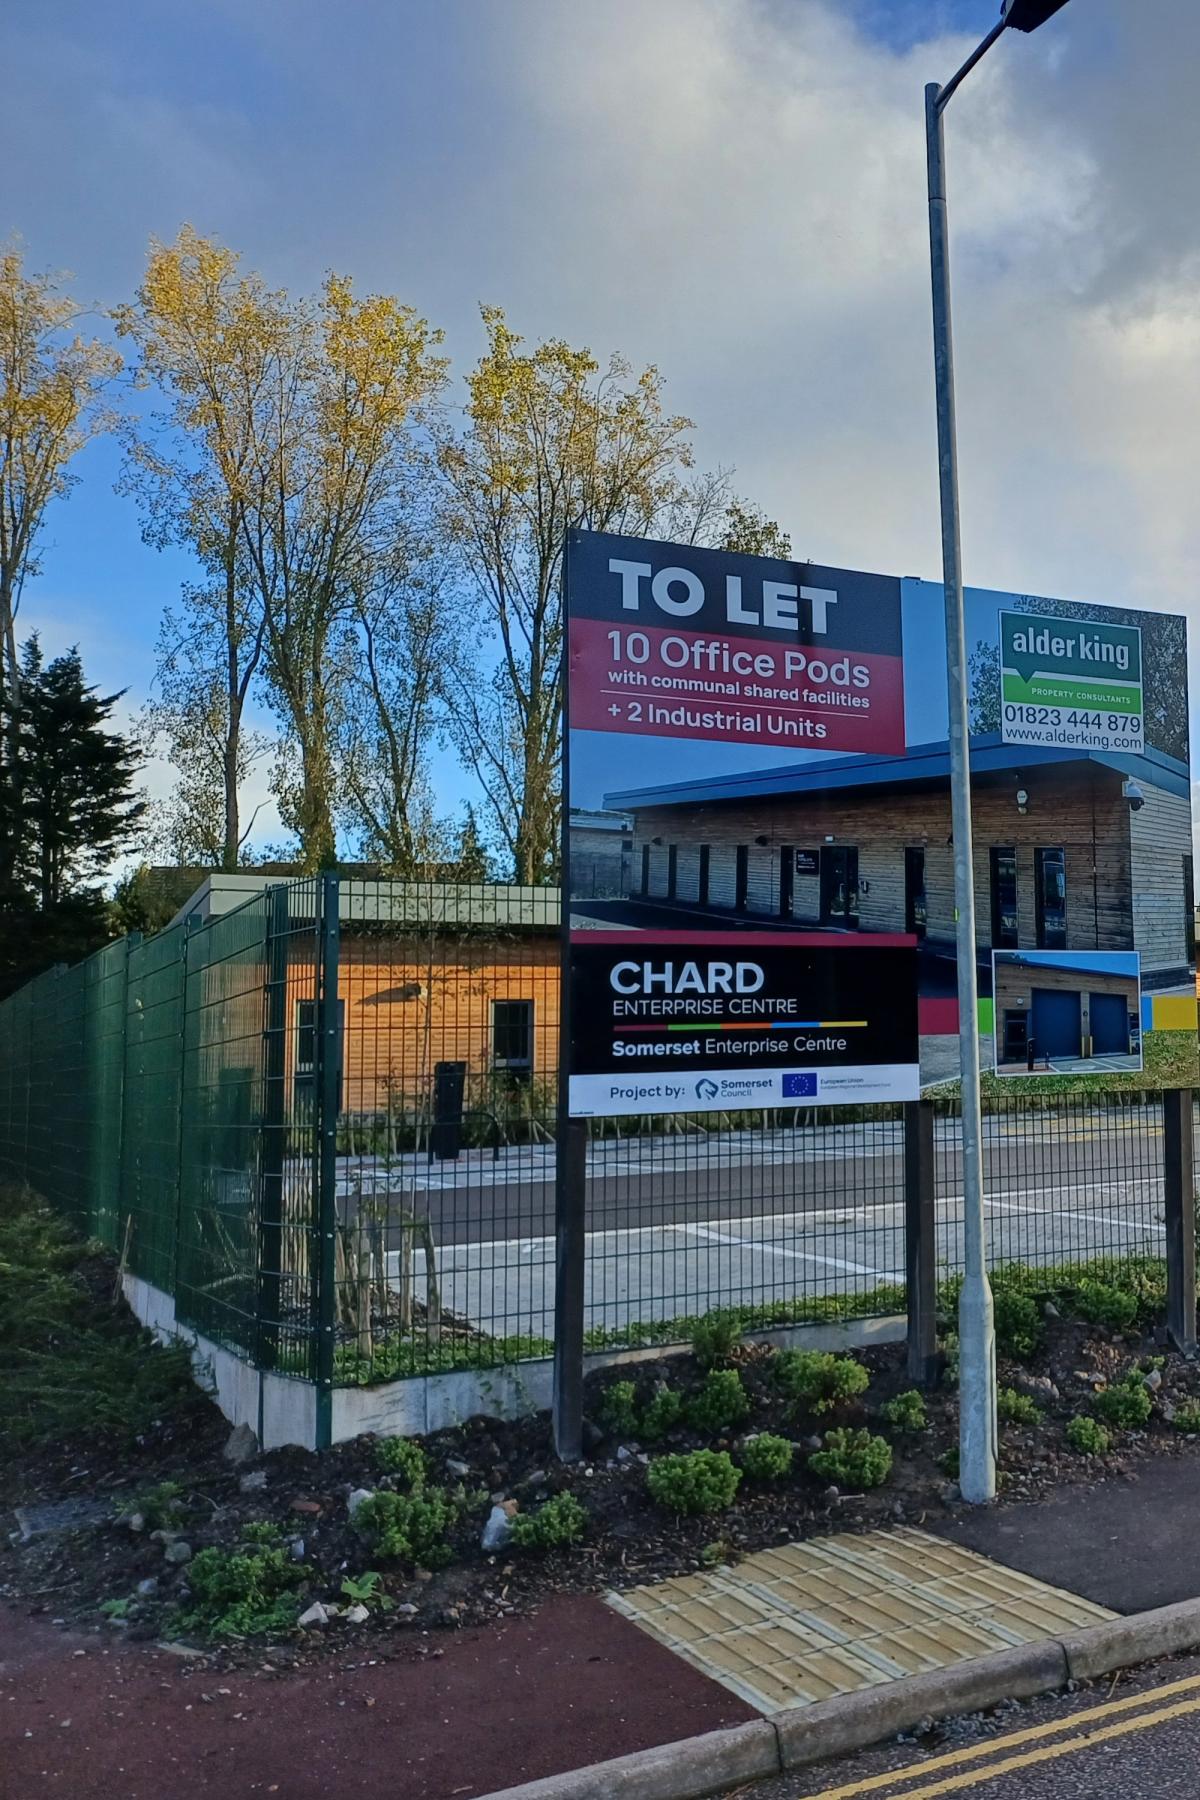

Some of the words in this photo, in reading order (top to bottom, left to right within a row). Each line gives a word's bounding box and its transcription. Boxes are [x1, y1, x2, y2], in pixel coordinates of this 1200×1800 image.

[608, 558, 705, 617] TO
[726, 575, 838, 634] LET
[607, 630, 650, 663] 10
[660, 637, 775, 678] Office
[785, 650, 870, 688] Pods
[1013, 627, 1075, 658] alder
[1079, 633, 1129, 670] king
[608, 670, 647, 686] with
[651, 674, 740, 696] communal
[744, 683, 799, 702] shared
[802, 689, 870, 709] facilities
[1031, 687, 1073, 698] PROPERTY
[1076, 692, 1131, 704] CONSULTANTS
[608, 704, 621, 716] +
[627, 702, 642, 722] 2
[649, 703, 761, 732] Industrial
[768, 715, 827, 738] Units
[1005, 704, 1061, 726] 01823
[1067, 711, 1102, 730] 444
[1107, 714, 1140, 733] 879
[1006, 727, 1142, 750] www.alderking.com
[610, 961, 764, 994] CHARD
[613, 999, 723, 1016] ENTERPRISE
[729, 998, 797, 1014] CENTRE
[612, 1038, 700, 1057] Somerset
[705, 1036, 788, 1058] Enterprise
[794, 1036, 847, 1052] Centre
[610, 1086, 661, 1100] Project
[665, 1085, 685, 1099] by:
[721, 1079, 772, 1089] Somerset
[721, 1088, 752, 1098] Council
